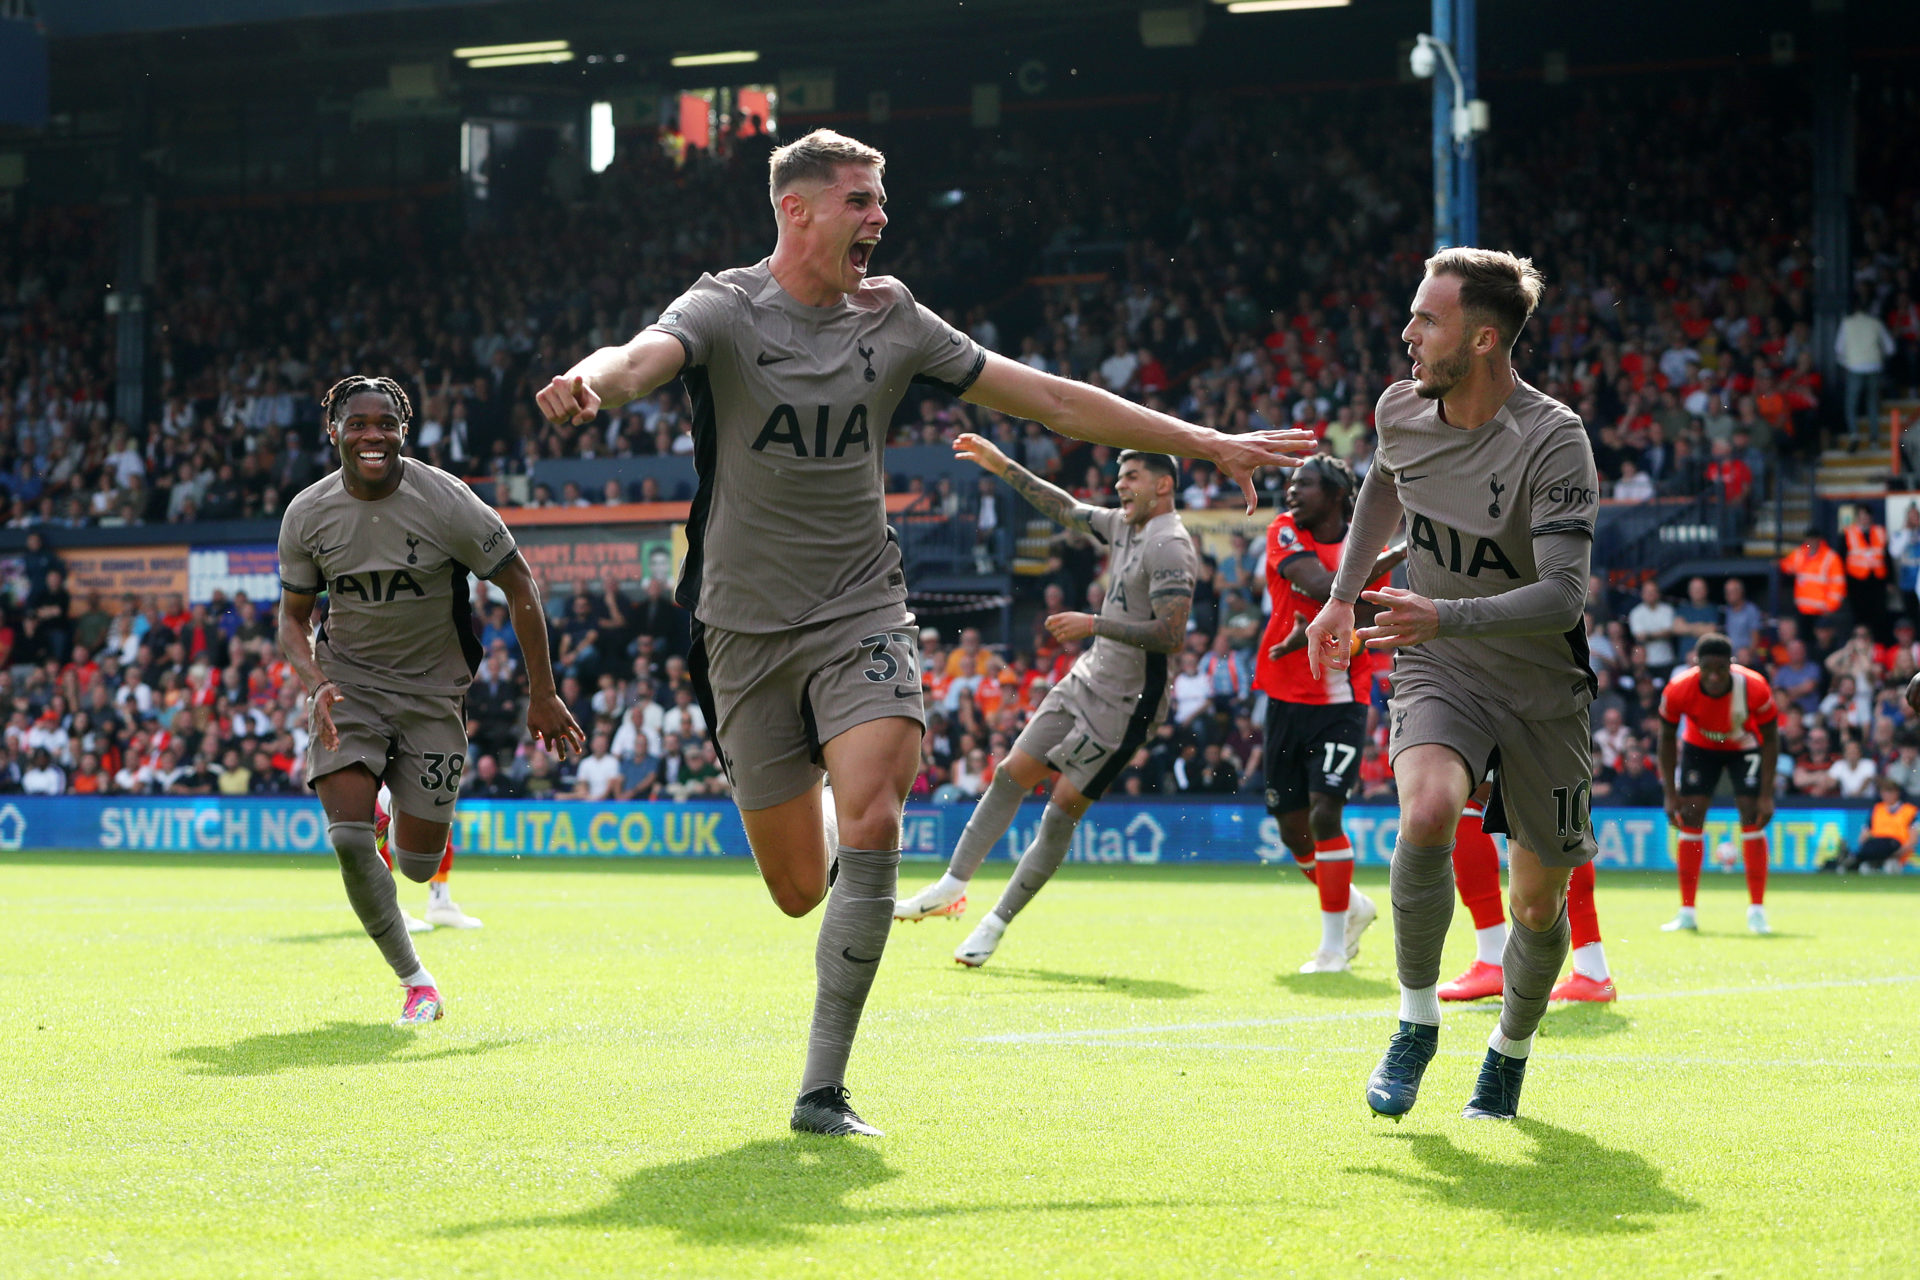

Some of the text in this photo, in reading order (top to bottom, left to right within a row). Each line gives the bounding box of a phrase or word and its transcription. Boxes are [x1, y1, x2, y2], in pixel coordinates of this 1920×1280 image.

[751, 403, 870, 458] AIA
[1411, 513, 1521, 580] AIA
[336, 569, 426, 602] AIA
[860, 632, 916, 683] 37
[1071, 733, 1107, 765] 17
[1322, 742, 1357, 775] 17
[1744, 753, 1761, 777] 7
[419, 752, 465, 793] 38
[99, 807, 249, 849] SWITCH
[1552, 778, 1592, 837] 10
[456, 810, 724, 854] TILITA.CO.UK
[1596, 819, 1654, 867] AT
